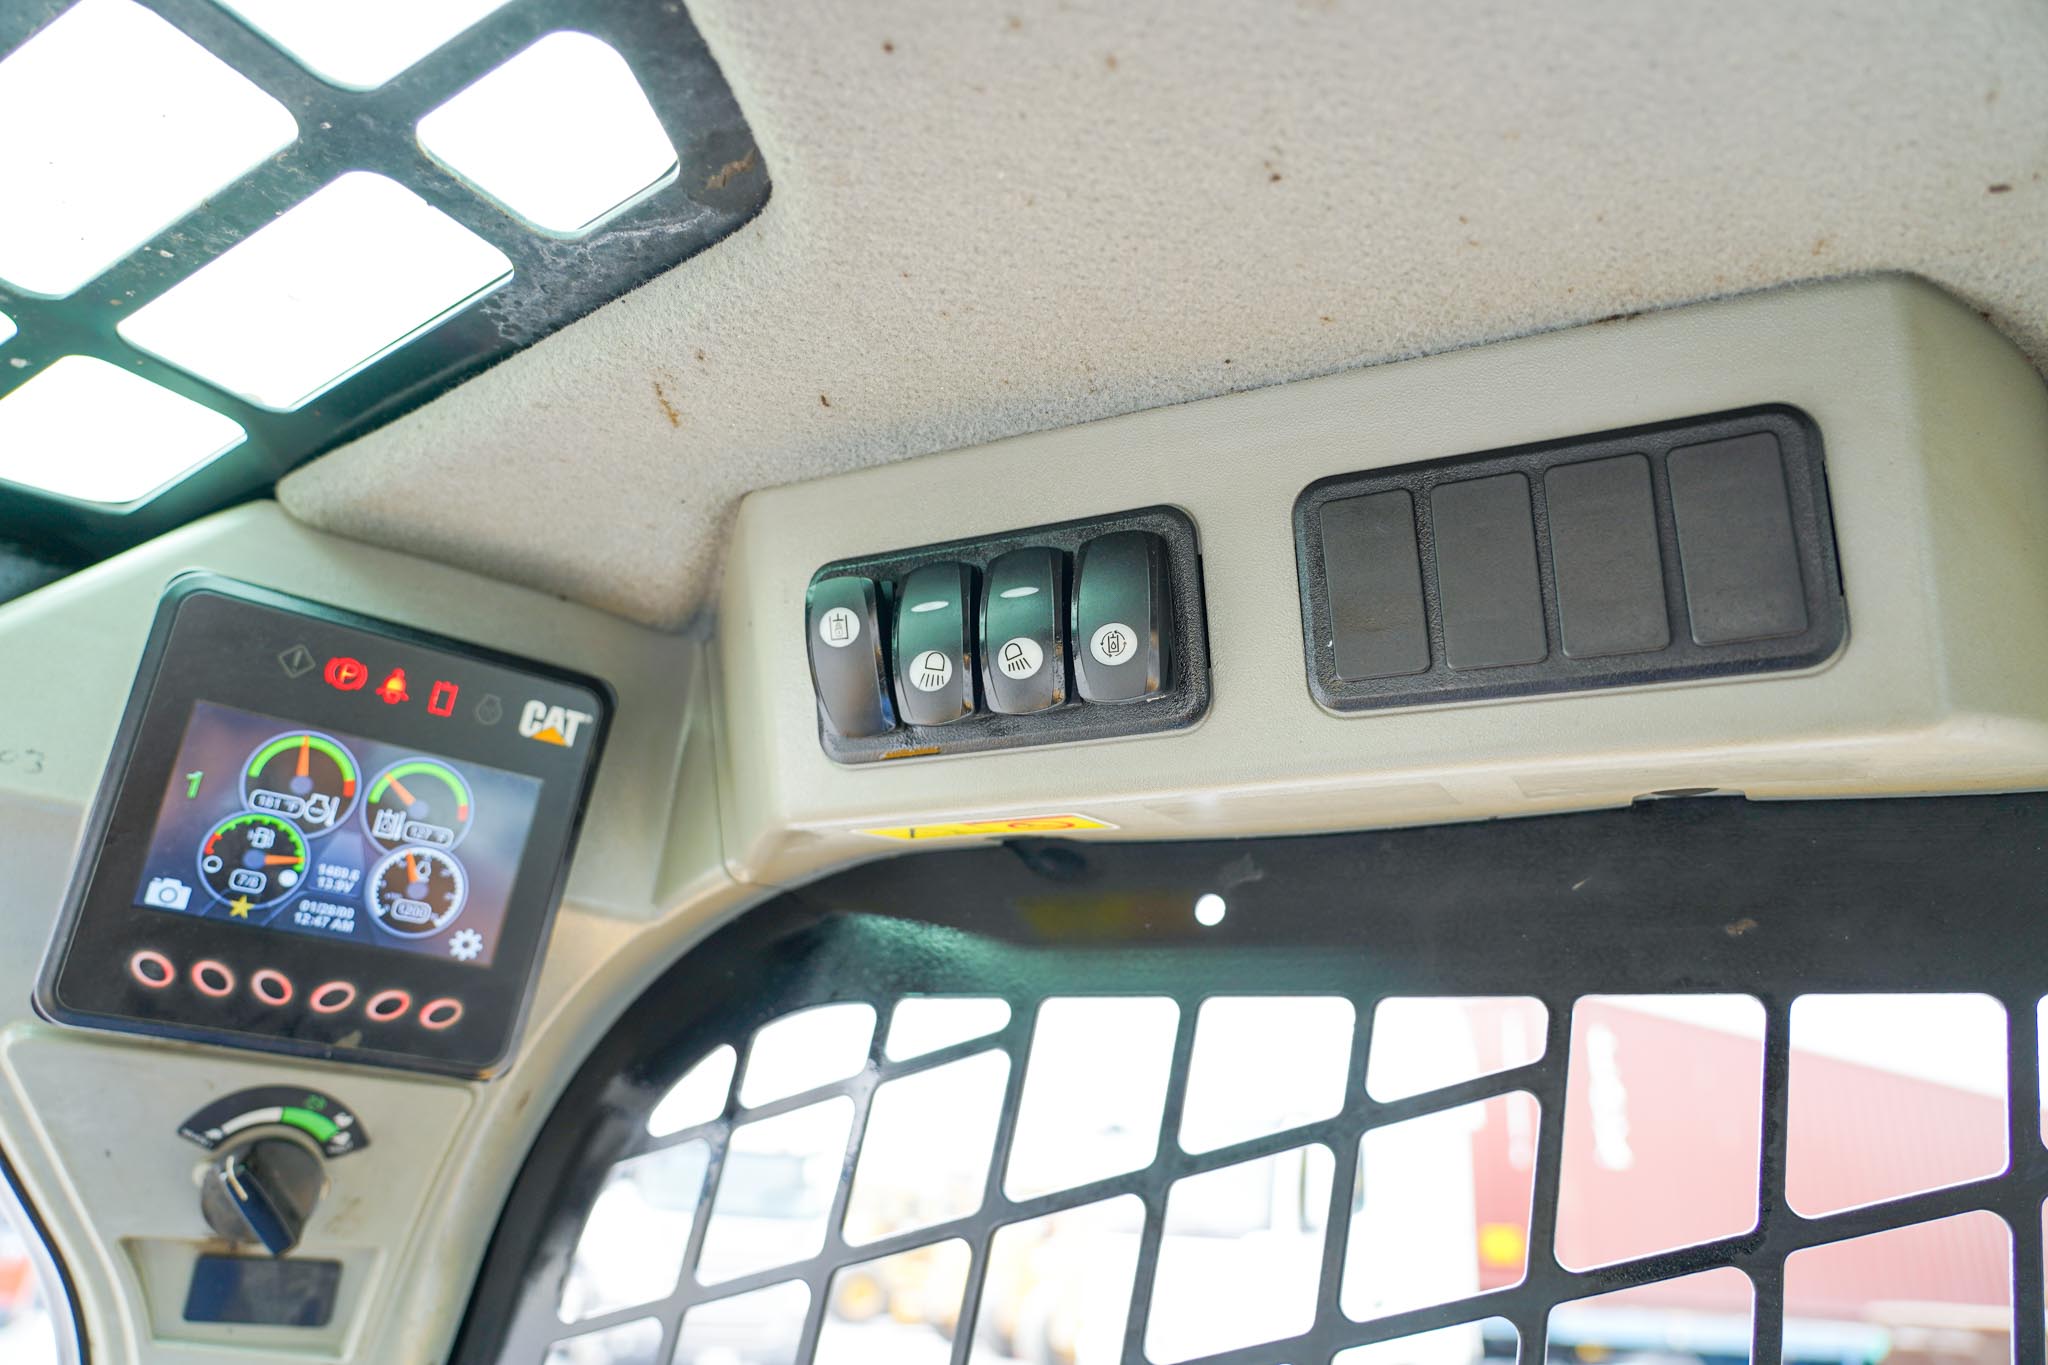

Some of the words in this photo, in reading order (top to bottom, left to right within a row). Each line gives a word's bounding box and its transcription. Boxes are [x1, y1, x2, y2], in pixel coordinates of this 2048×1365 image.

[519, 700, 588, 748] CAT
[185, 770, 204, 800] 1
[329, 918, 355, 934] AM
